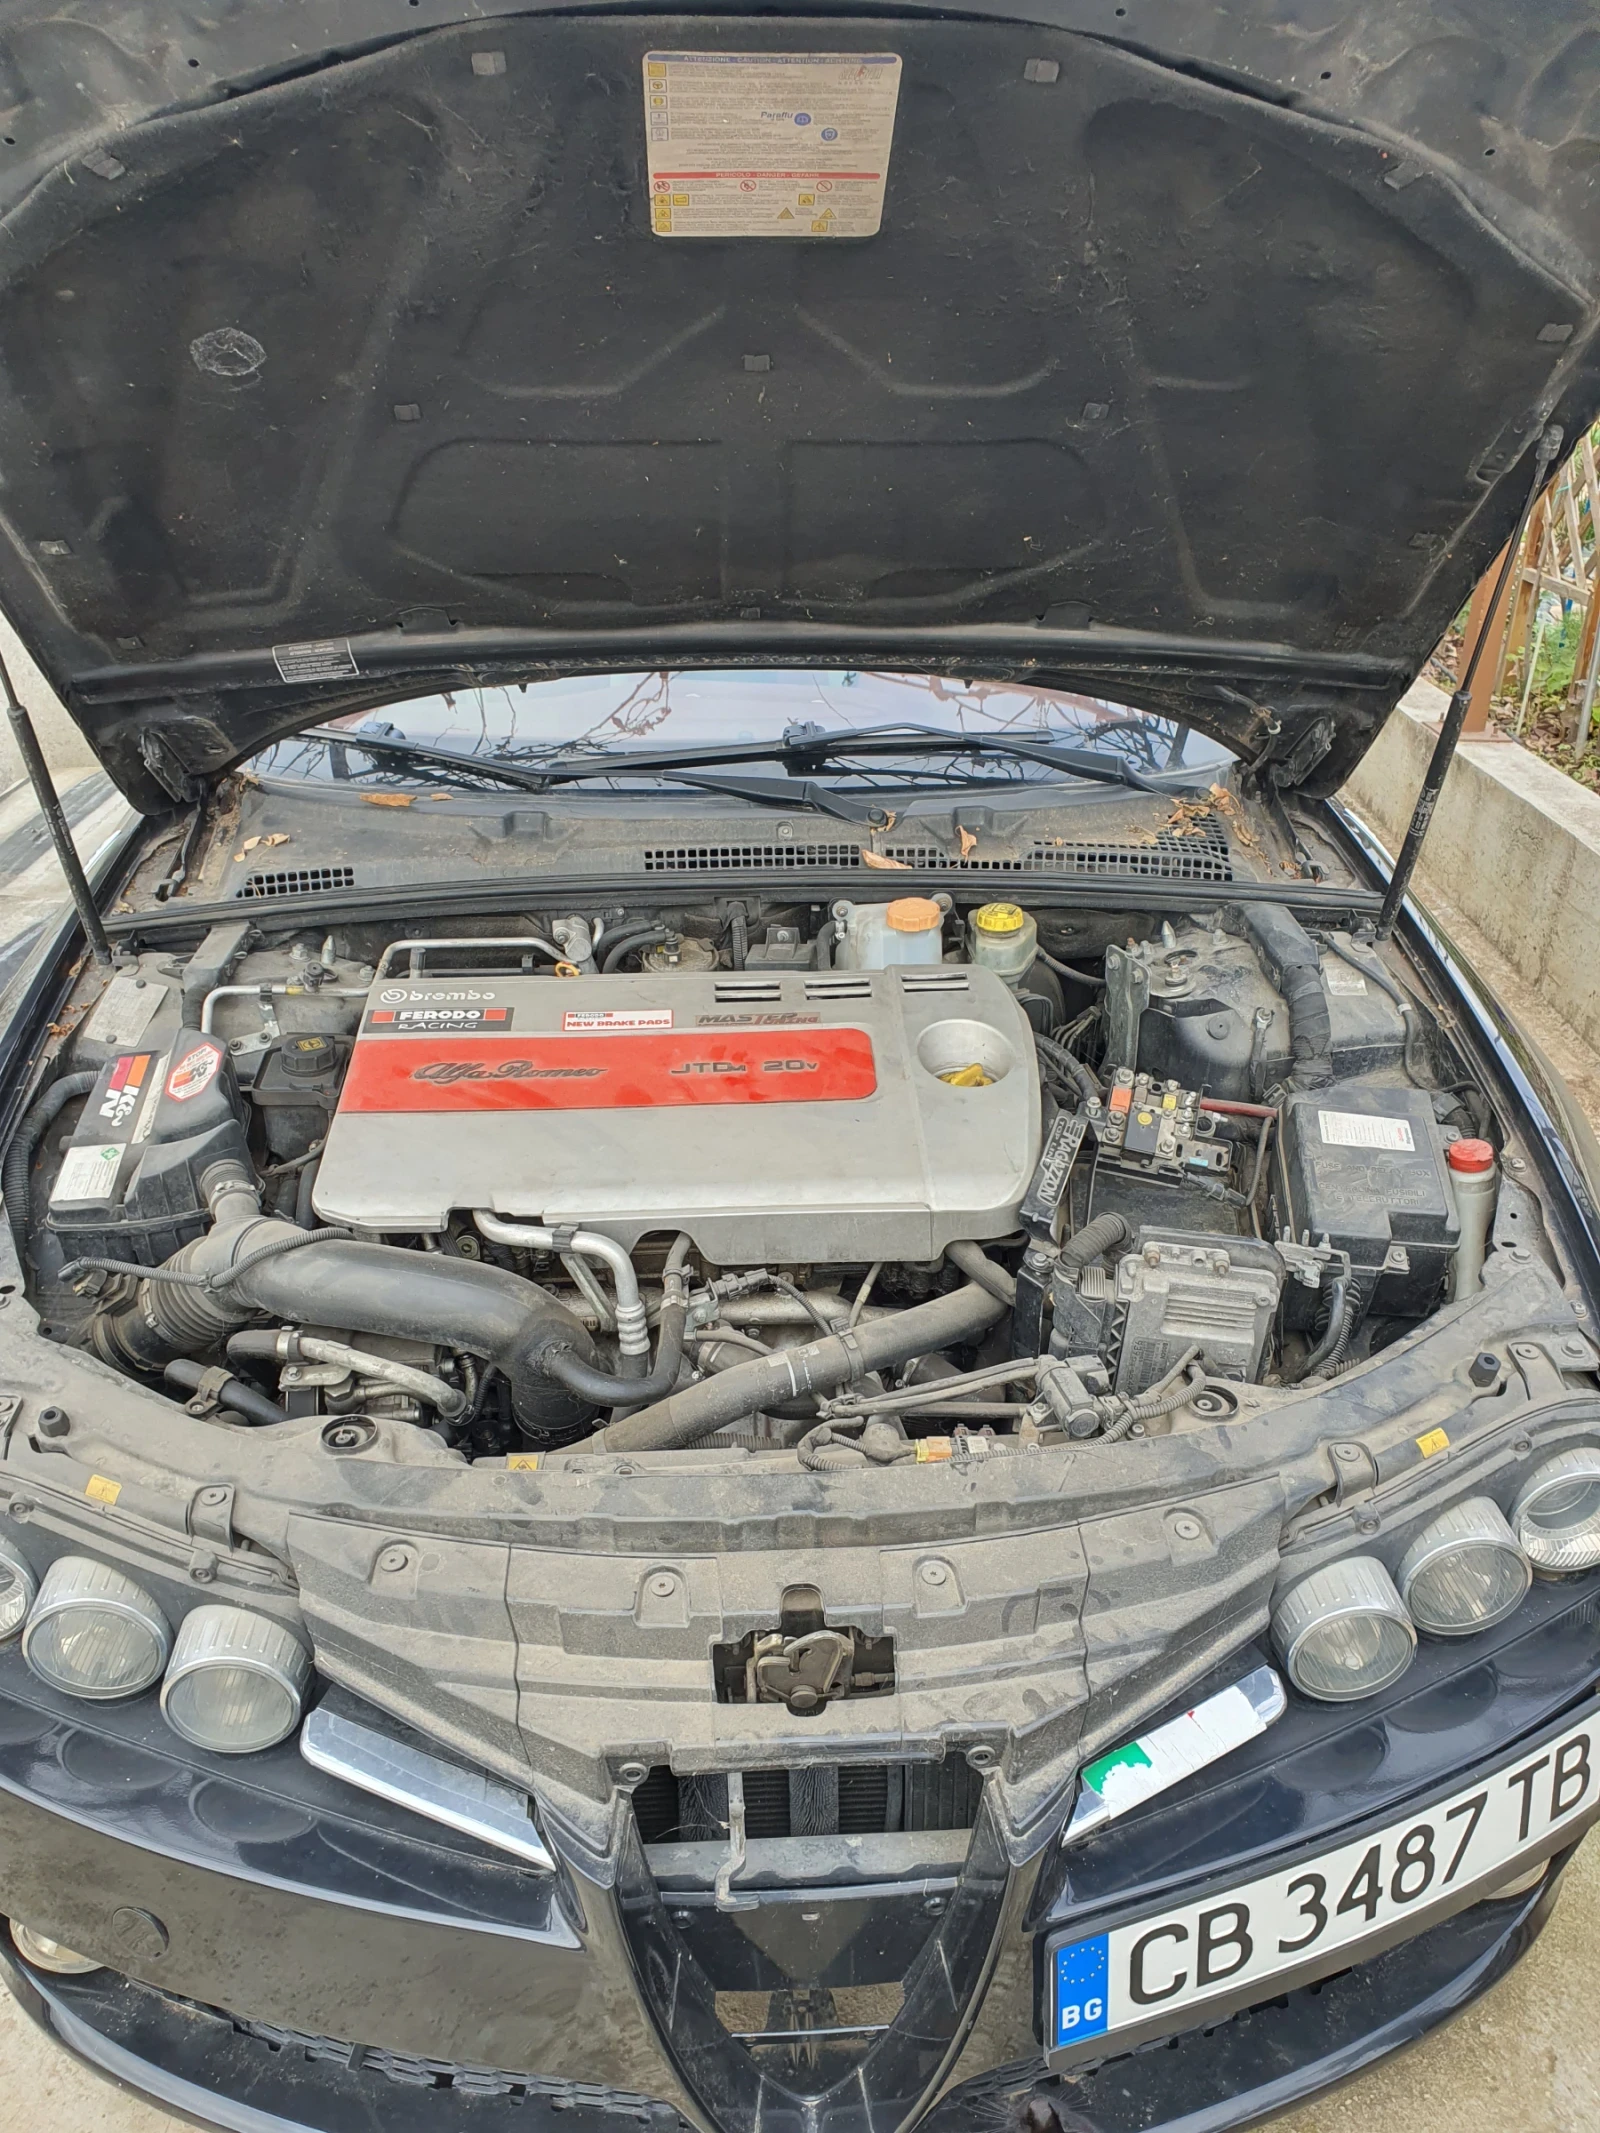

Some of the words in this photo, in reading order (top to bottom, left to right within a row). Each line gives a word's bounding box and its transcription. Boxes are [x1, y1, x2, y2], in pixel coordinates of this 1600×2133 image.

[409, 989, 496, 1001] brembo
[399, 1010, 481, 1021] FERODO
[397, 1022, 479, 1030] RACING
[410, 1062, 494, 1085] Alfa
[493, 1059, 608, 1079] Romeo
[1055, 1120, 1065, 1140] TOP
[1315, 1161, 1340, 1170] FUSE
[1128, 1901, 1255, 2005] CB
[1277, 1791, 1489, 1955] 3487
[1508, 1733, 1592, 1842] TB
[1061, 1997, 1103, 2030] BG
